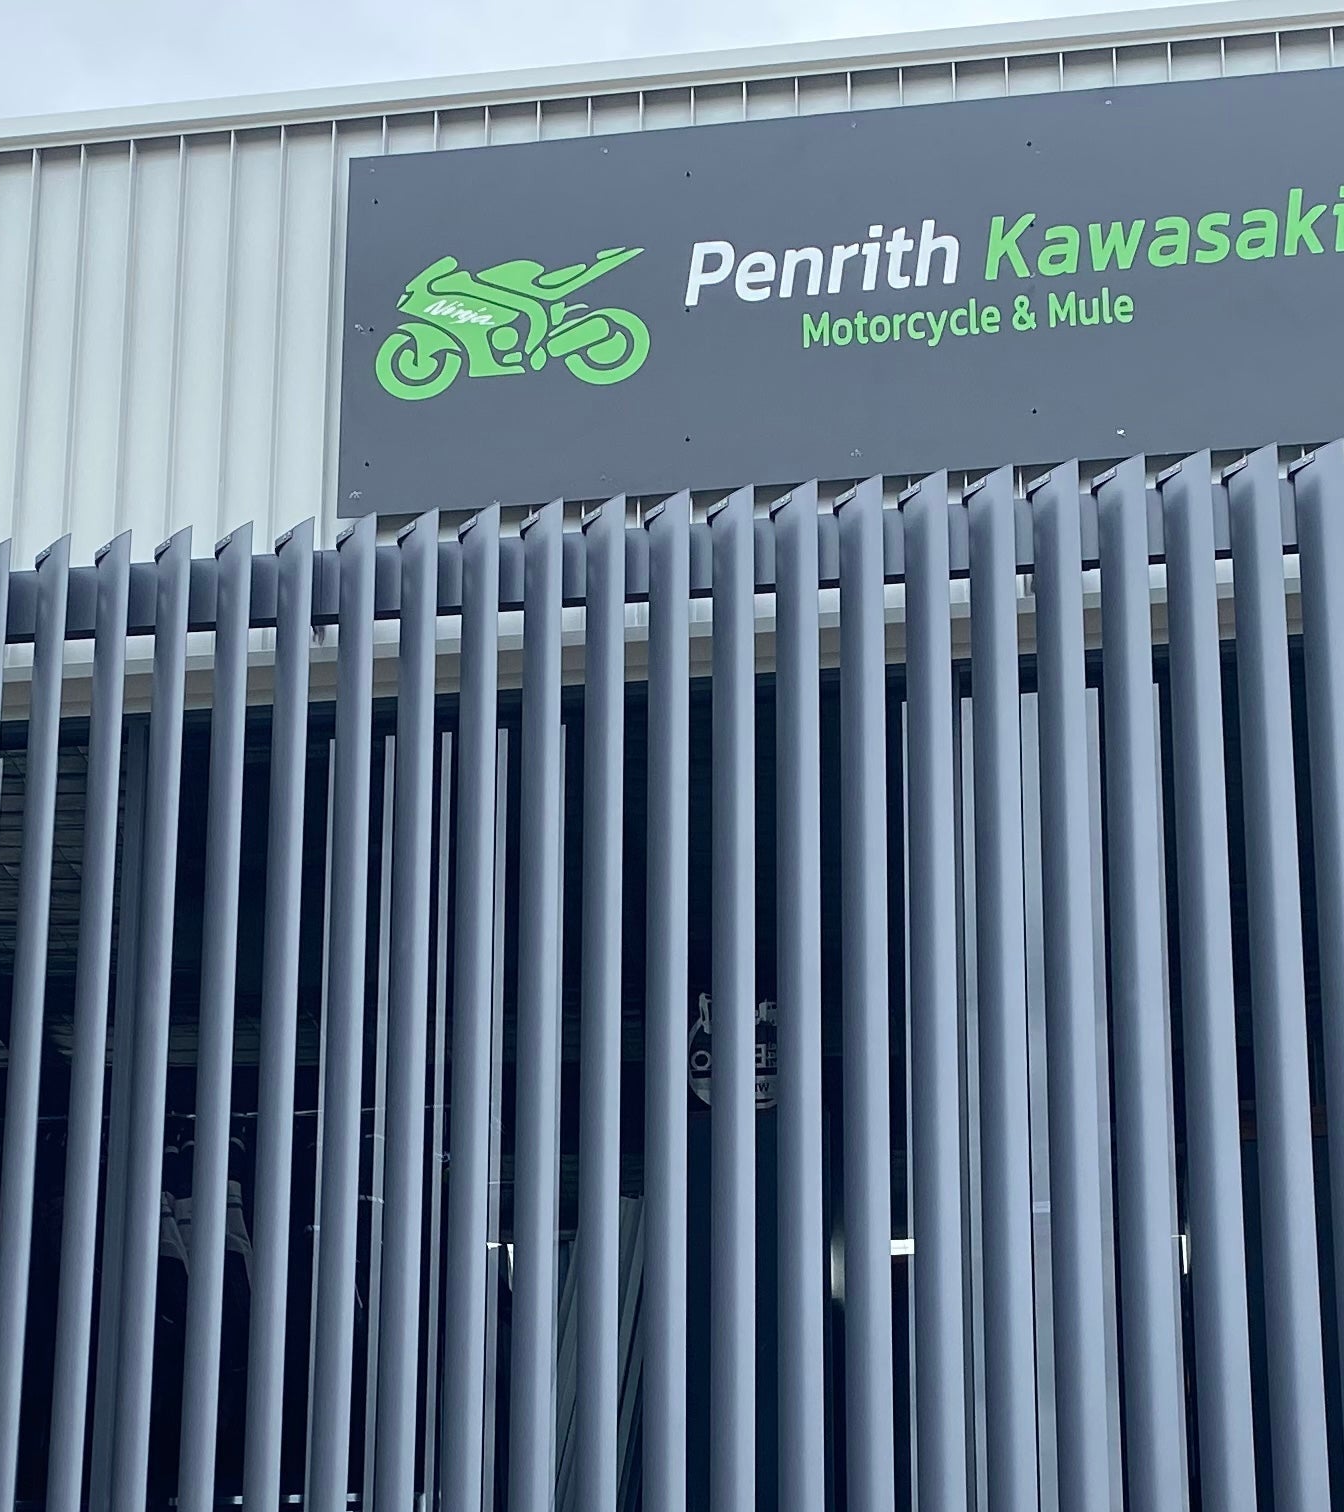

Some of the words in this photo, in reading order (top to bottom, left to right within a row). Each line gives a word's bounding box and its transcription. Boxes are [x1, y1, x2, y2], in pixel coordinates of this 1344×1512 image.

[685, 219, 959, 307] Penrith
[802, 299, 1002, 350] Motorcycle
[1012, 296, 1036, 332] &
[1048, 291, 1135, 328] Mule
